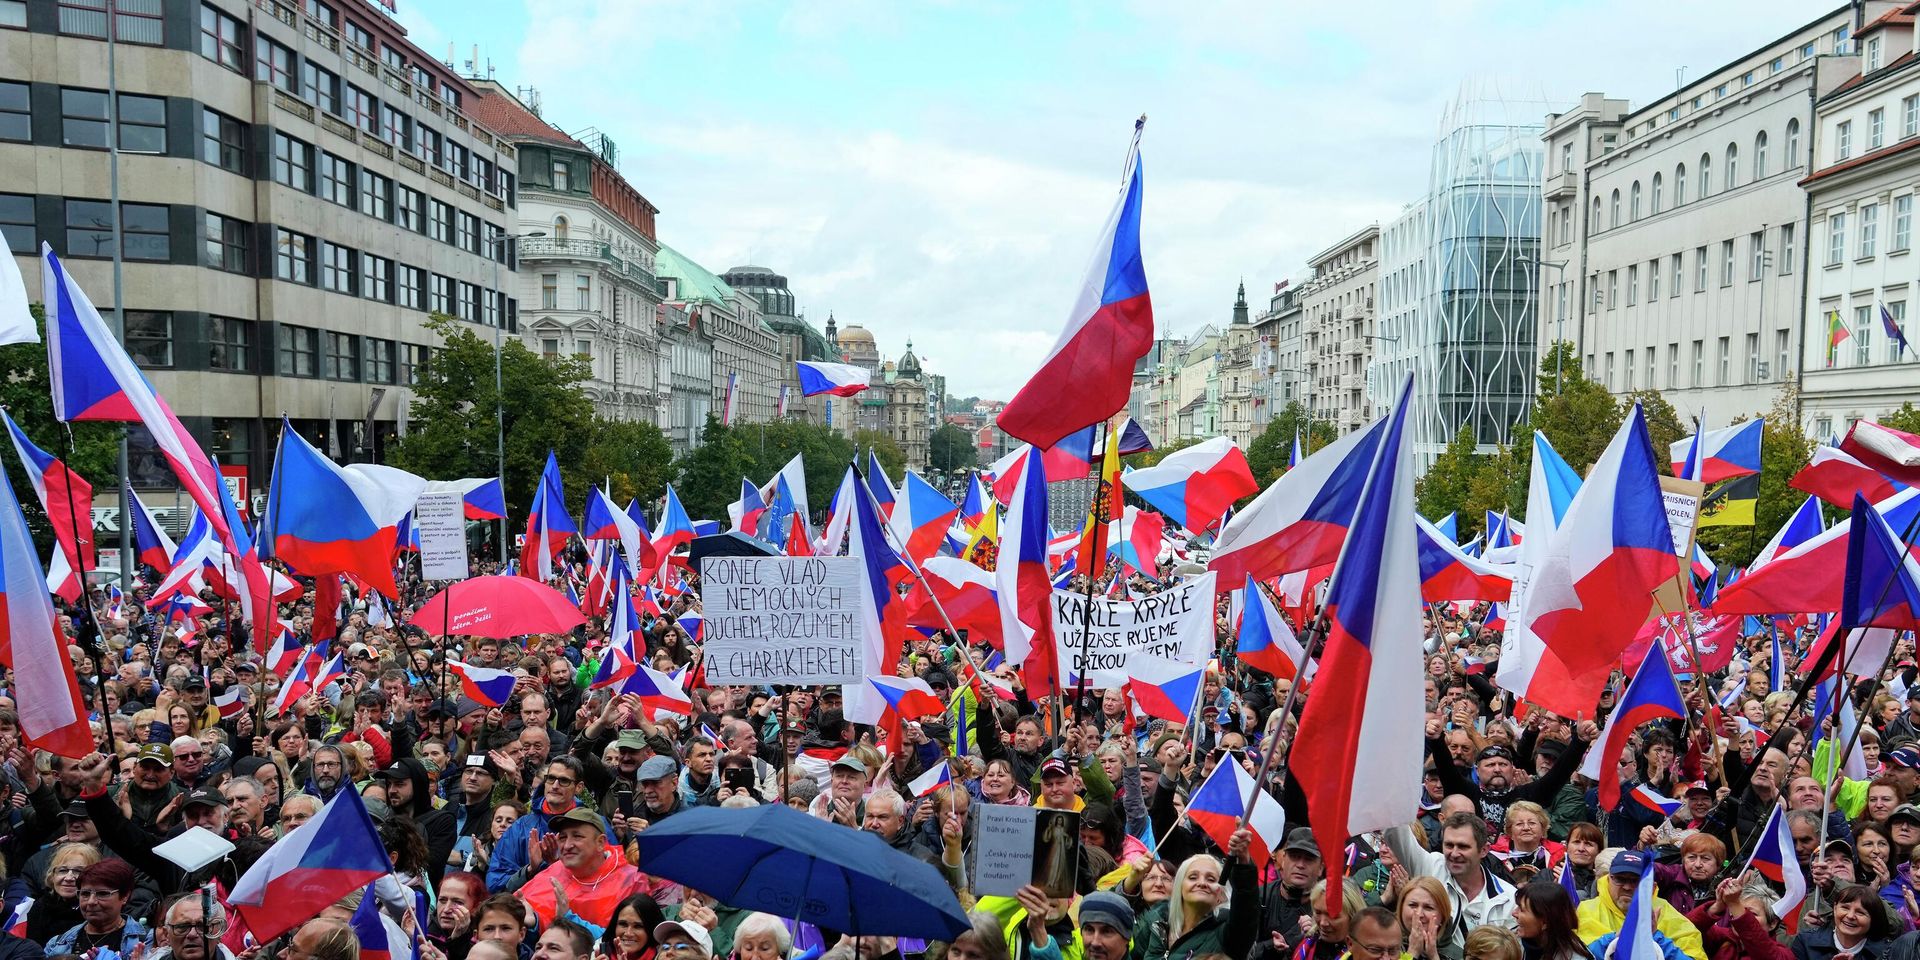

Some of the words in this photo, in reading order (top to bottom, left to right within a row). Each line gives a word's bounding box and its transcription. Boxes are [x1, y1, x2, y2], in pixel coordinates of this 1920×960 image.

[1662, 494, 1696, 506] EMISNÍCH
[93, 508, 168, 532] KC
[704, 559, 762, 585] KONEC
[778, 558, 827, 585] VLÁD
[726, 584, 842, 611] NEMOCNÝCH
[1058, 596, 1120, 627] KARLE
[704, 616, 768, 642] DUCHEM,
[770, 613, 853, 640] ROZUMEM
[1063, 629, 1082, 648] UŽ
[1087, 632, 1121, 648] ZASE
[1127, 621, 1178, 646] RYJEME
[706, 655, 720, 678] A
[730, 647, 855, 677] CHARAKTEREM
[1074, 651, 1126, 670] DRŽKOU
